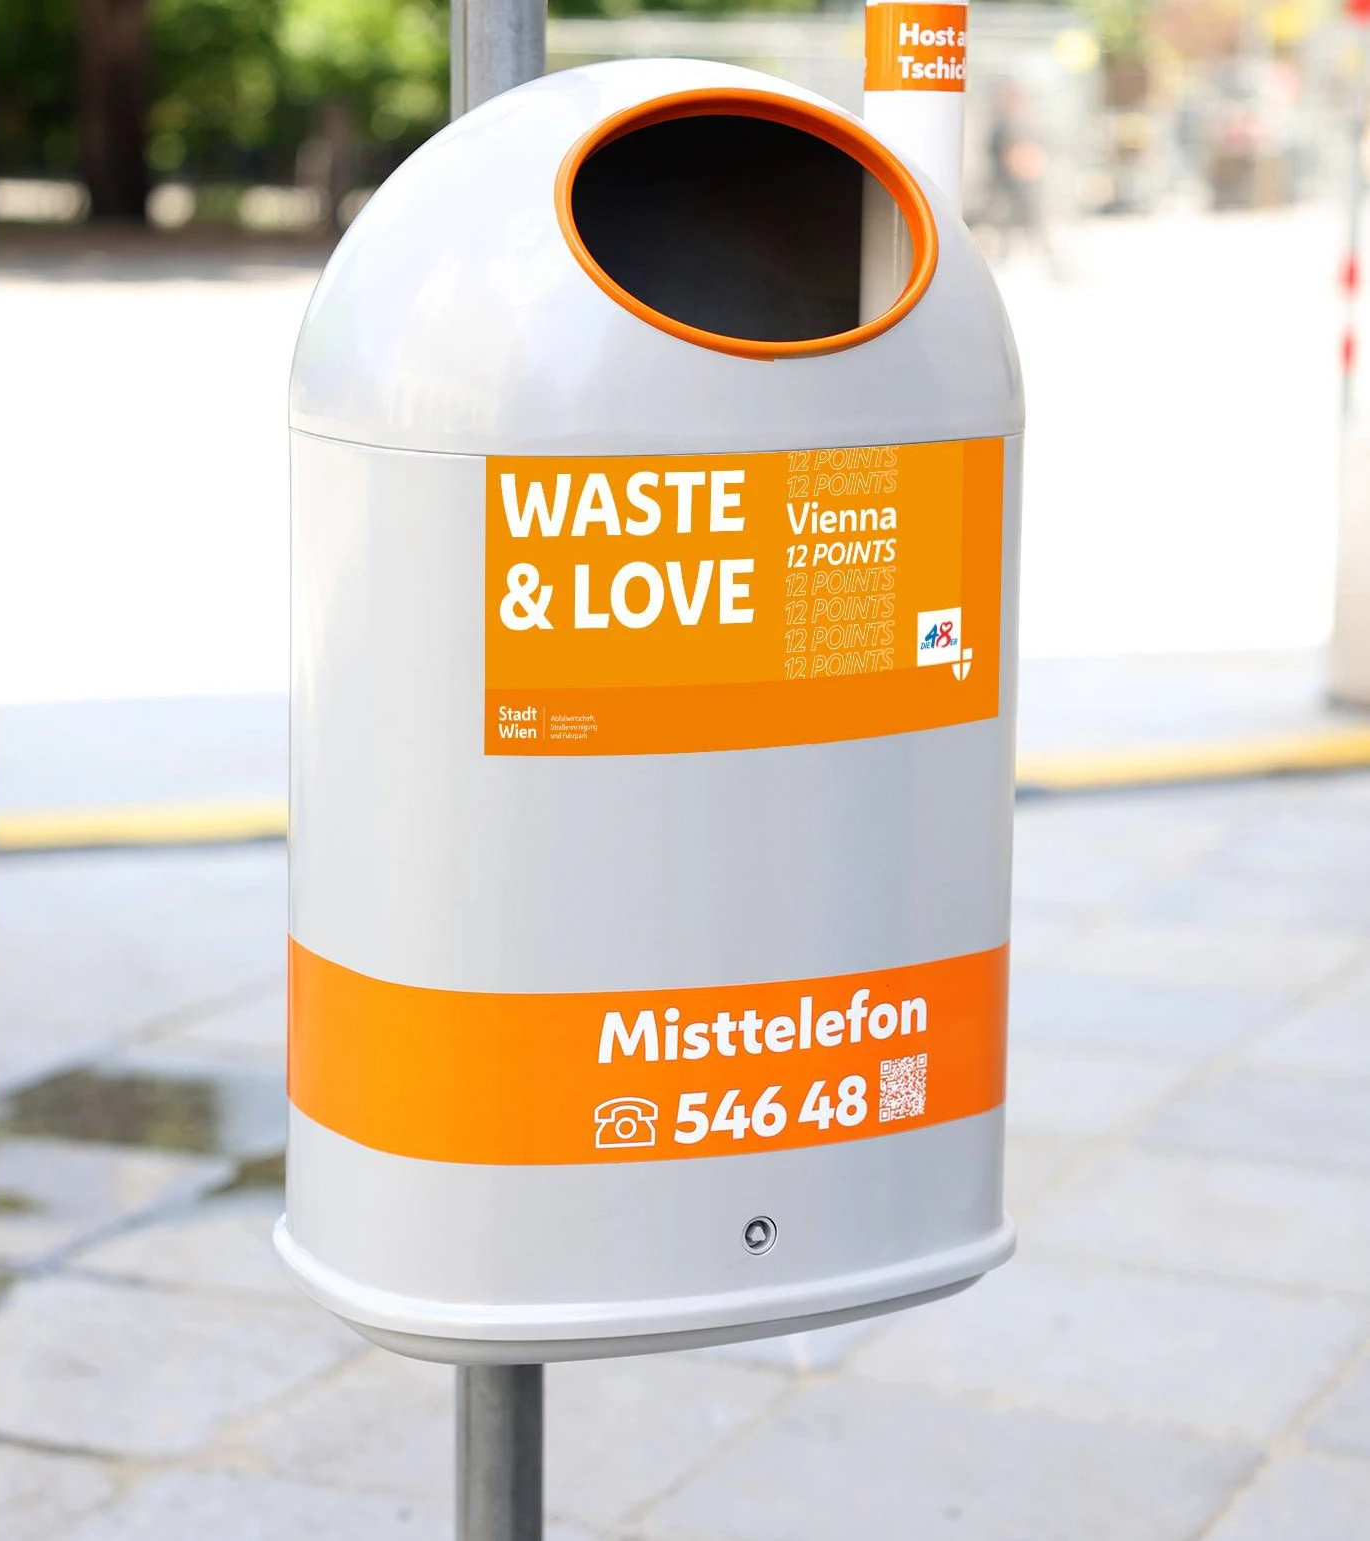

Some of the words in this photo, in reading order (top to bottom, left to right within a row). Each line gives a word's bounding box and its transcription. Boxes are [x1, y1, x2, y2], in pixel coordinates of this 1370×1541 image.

[899, 22, 955, 47] Host
[787, 450, 810, 472] 12
[813, 446, 899, 470] POINTS
[787, 475, 810, 498] 12
[813, 469, 898, 497] POINTS
[500, 469, 745, 538] WASTE
[786, 501, 897, 535] Vienna
[786, 544, 808, 568] 12
[812, 538, 897, 567] POINTS
[499, 562, 554, 631] &
[574, 558, 755, 629] LOVE
[785, 573, 808, 597] 12
[811, 566, 896, 595] POINTS
[784, 601, 808, 625] 12
[811, 593, 896, 623] POINTS
[784, 628, 807, 653] 12
[811, 620, 895, 651] POINTS
[784, 656, 807, 680] 12
[811, 648, 895, 678] POINTS
[498, 705, 538, 722] Stadt
[498, 723, 537, 740] Wien
[597, 988, 928, 1064] Misttelefon
[674, 1085, 787, 1144] 546
[798, 1075, 868, 1129] 48
